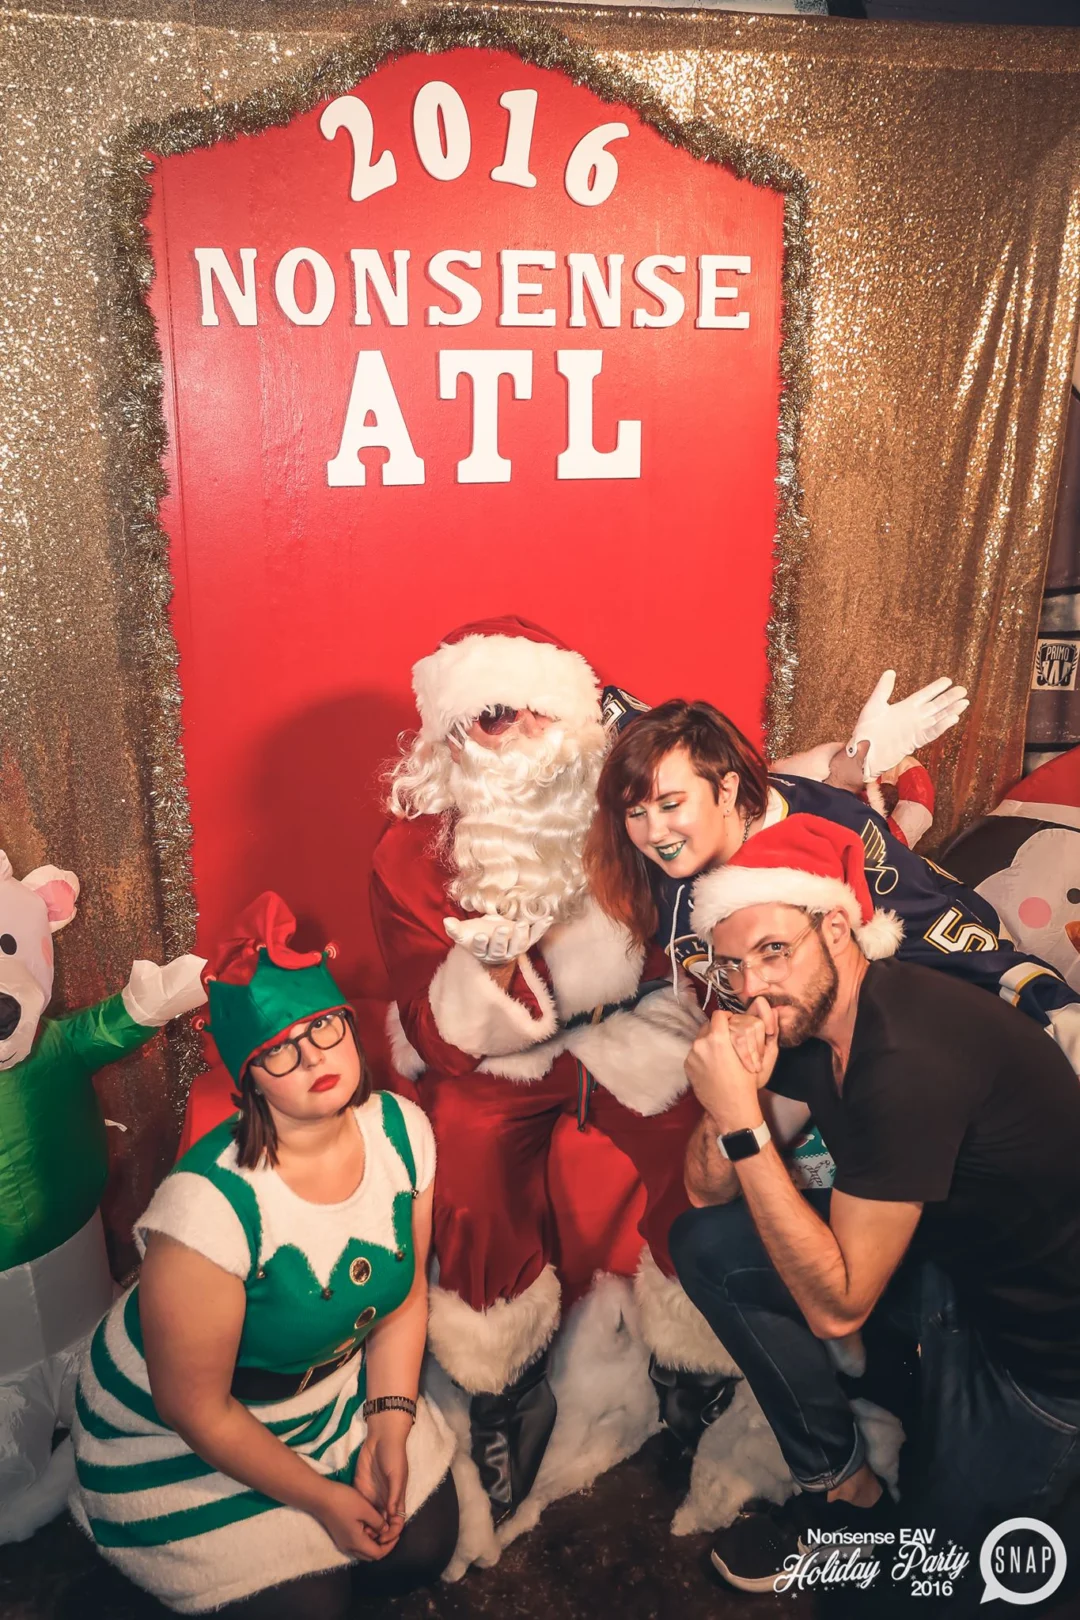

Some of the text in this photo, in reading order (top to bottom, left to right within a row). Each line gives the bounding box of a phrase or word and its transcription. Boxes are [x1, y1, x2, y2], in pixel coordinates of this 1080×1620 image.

[319, 80, 630, 207] 2016
[193, 246, 752, 330] NONSENSE
[326, 349, 642, 487] ATL
[1045, 644, 1070, 662] PRIMO
